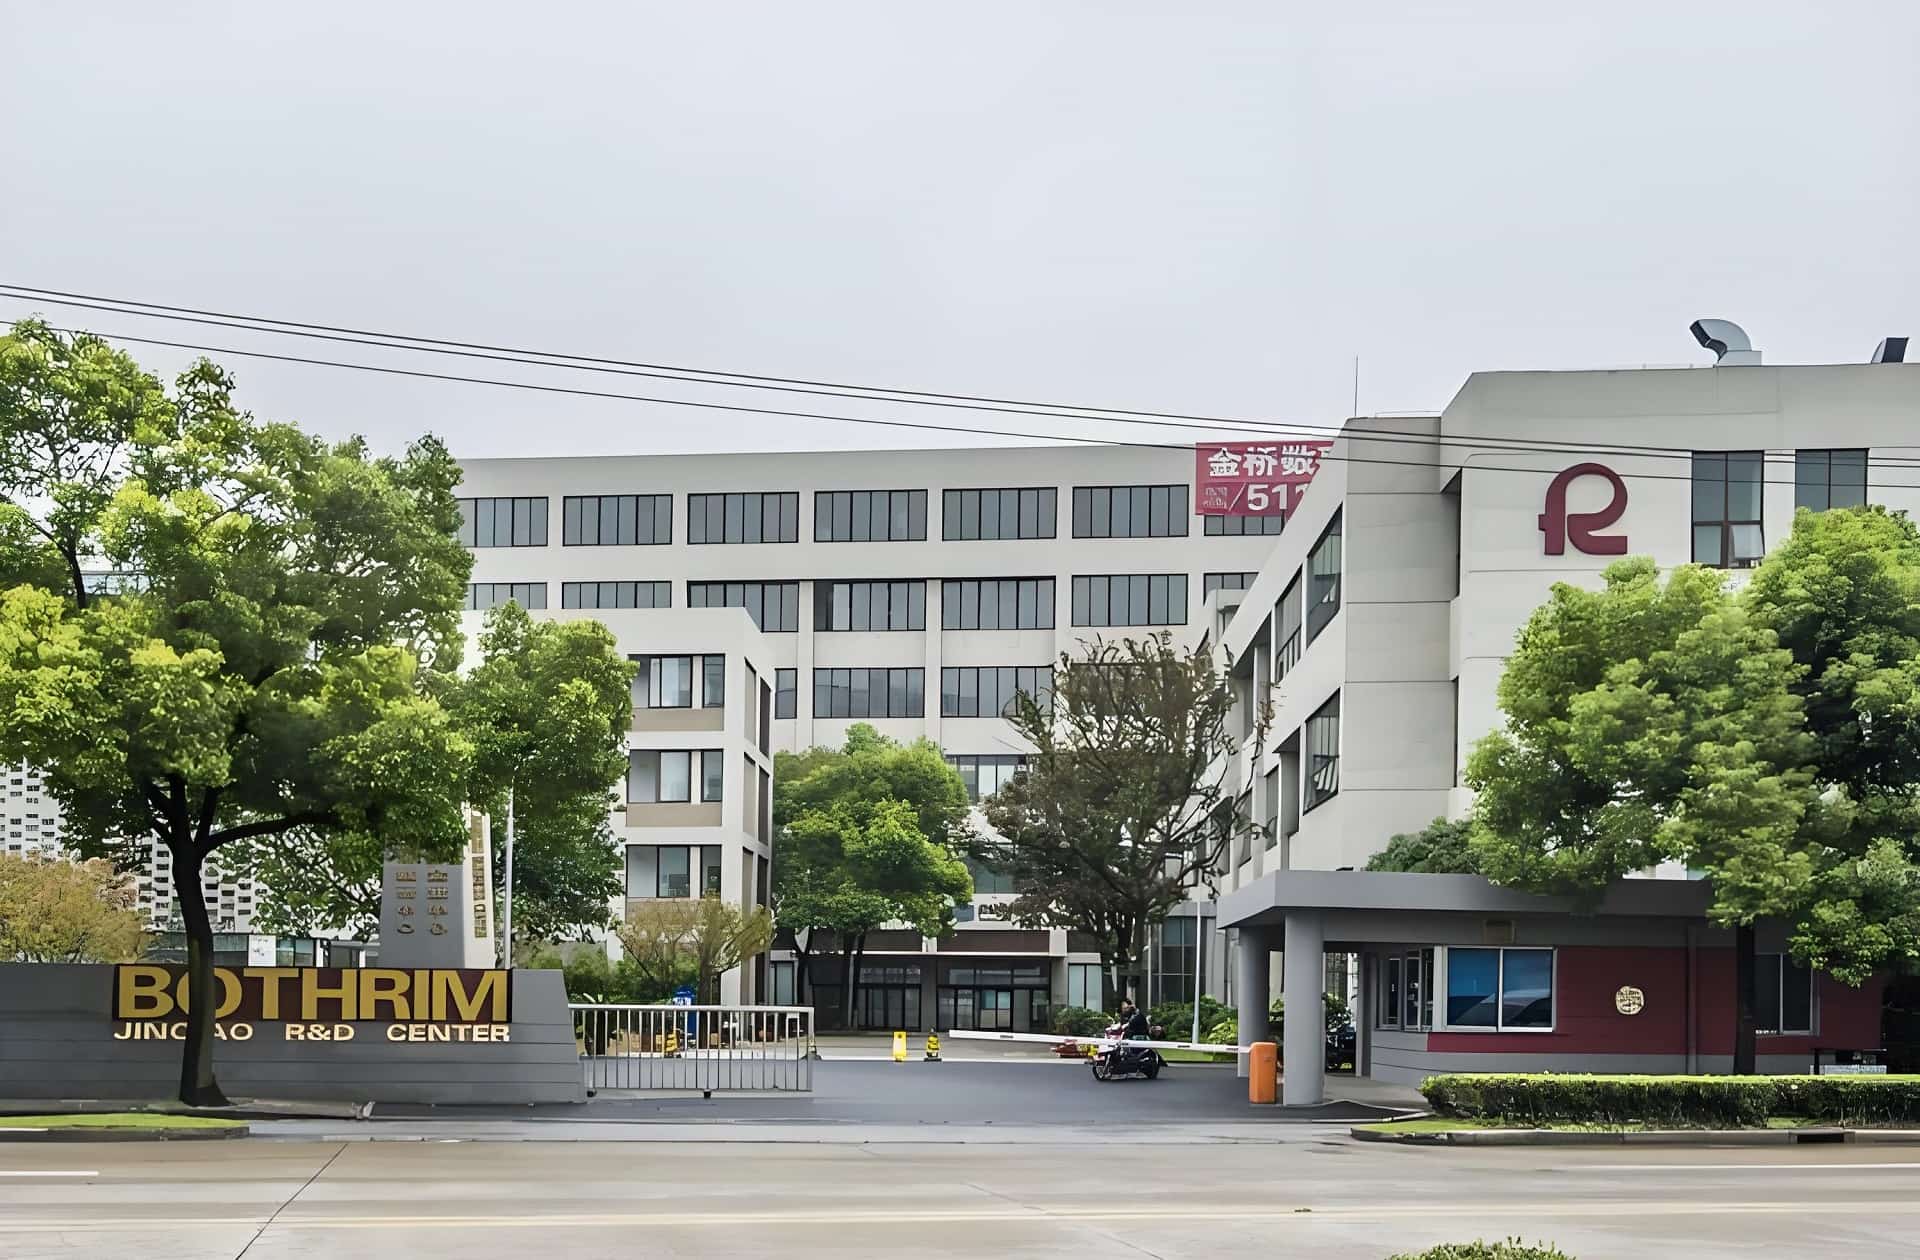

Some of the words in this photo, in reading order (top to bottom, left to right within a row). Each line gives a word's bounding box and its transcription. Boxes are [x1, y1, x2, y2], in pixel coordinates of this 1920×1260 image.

[1208, 445, 1330, 477] 金桥数
[119, 966, 508, 1021] BOTHRIM
[114, 1022, 253, 1040] JINAO
[285, 1023, 355, 1041] R&D
[386, 1023, 511, 1042] CENTER
